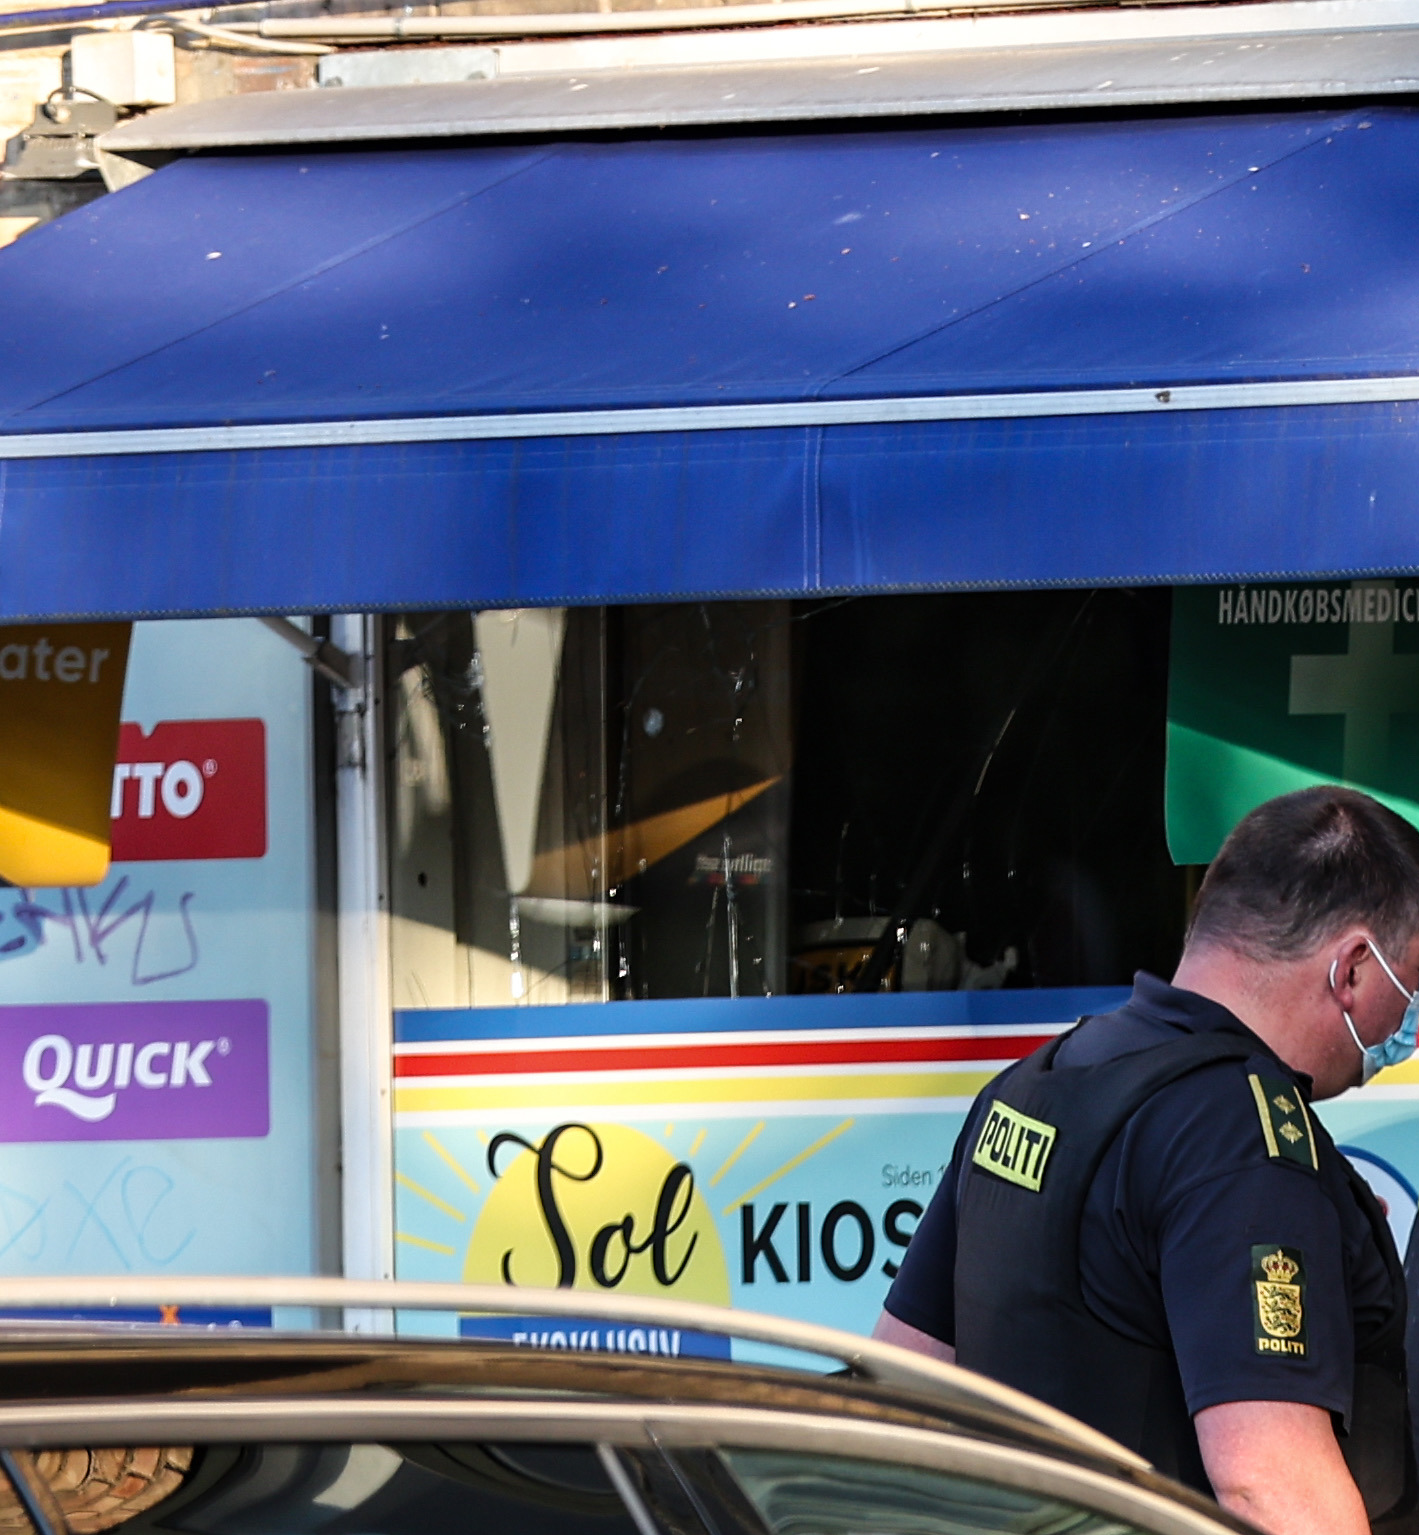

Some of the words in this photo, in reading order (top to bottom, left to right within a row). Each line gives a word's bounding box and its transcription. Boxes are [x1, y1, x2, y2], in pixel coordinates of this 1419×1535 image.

[110, 760, 205, 819] TTO
[977, 1110, 1050, 1180] POLITI
[881, 1164, 932, 1187] Siden
[487, 1123, 698, 1290] Sol
[740, 1199, 928, 1285] KIOS
[1258, 1337, 1304, 1356] POLITI
